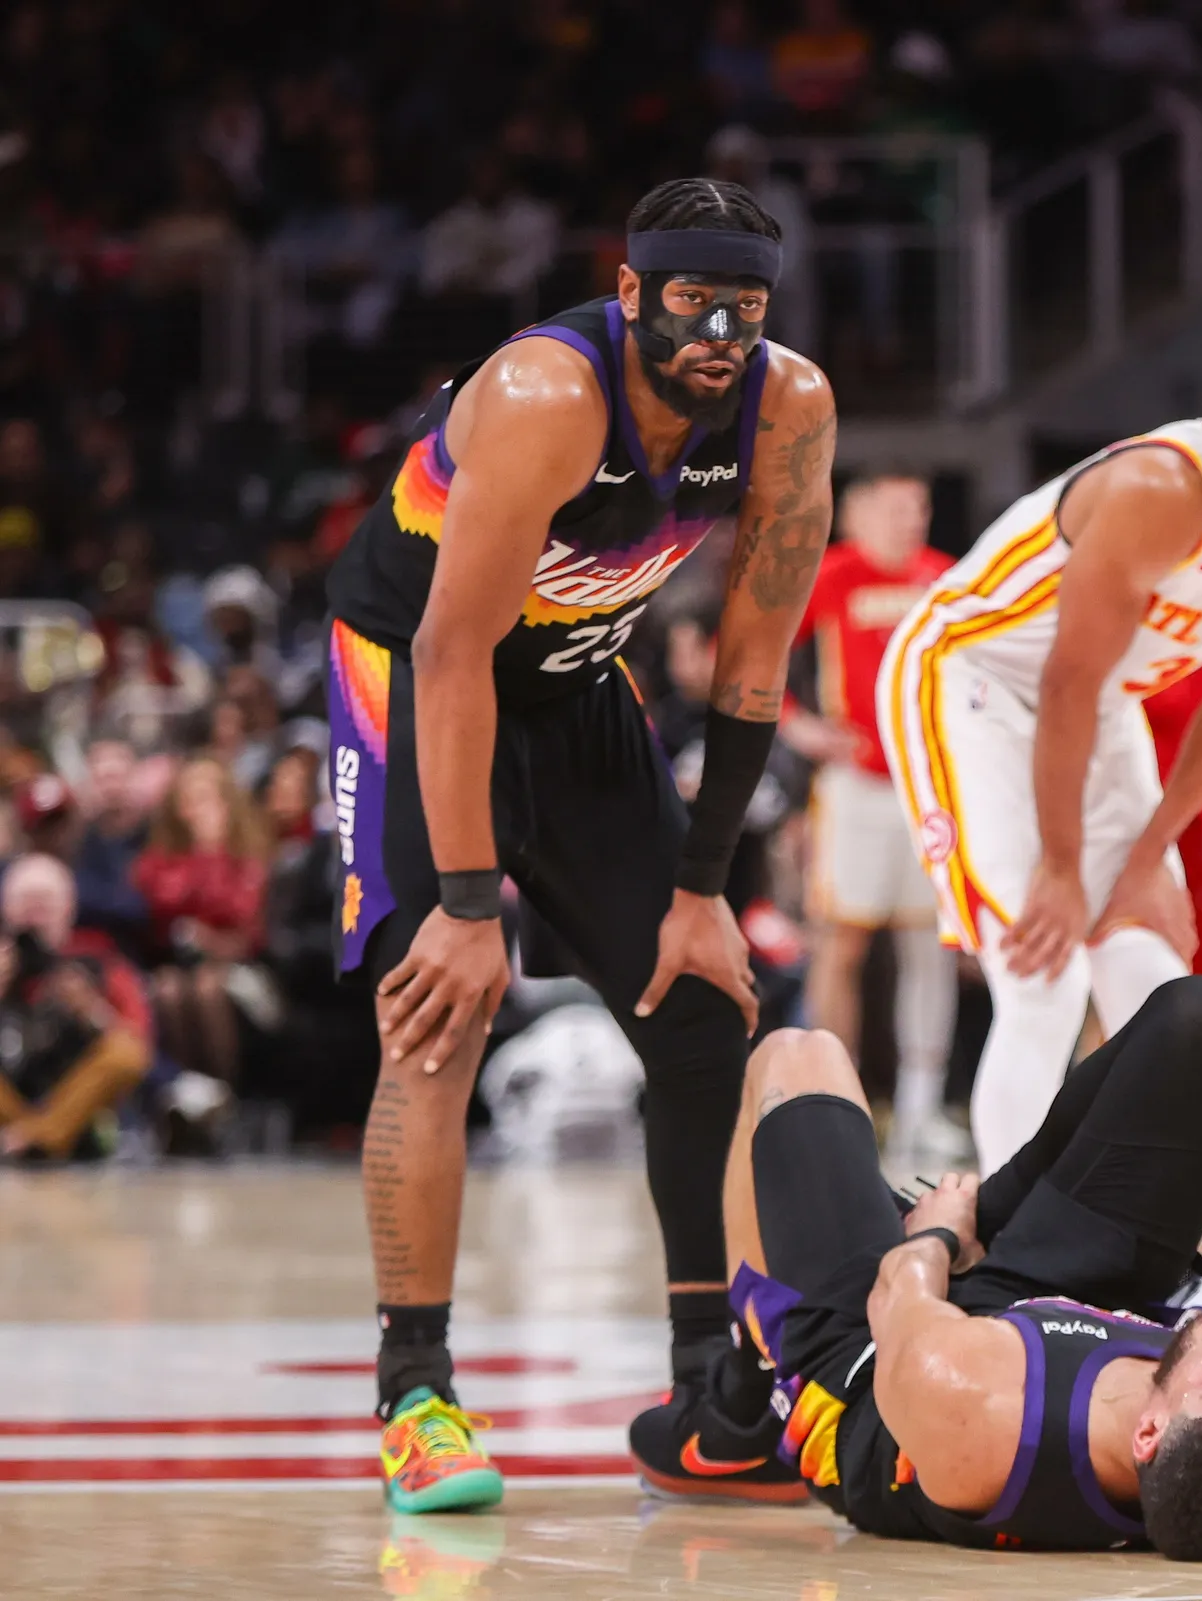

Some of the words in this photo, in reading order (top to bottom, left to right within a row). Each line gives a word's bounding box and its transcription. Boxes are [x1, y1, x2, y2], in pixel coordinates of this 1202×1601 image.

[679, 462, 738, 487] PayPal
[587, 565, 632, 579] THE
[1041, 1320, 1109, 1341] PayPal
